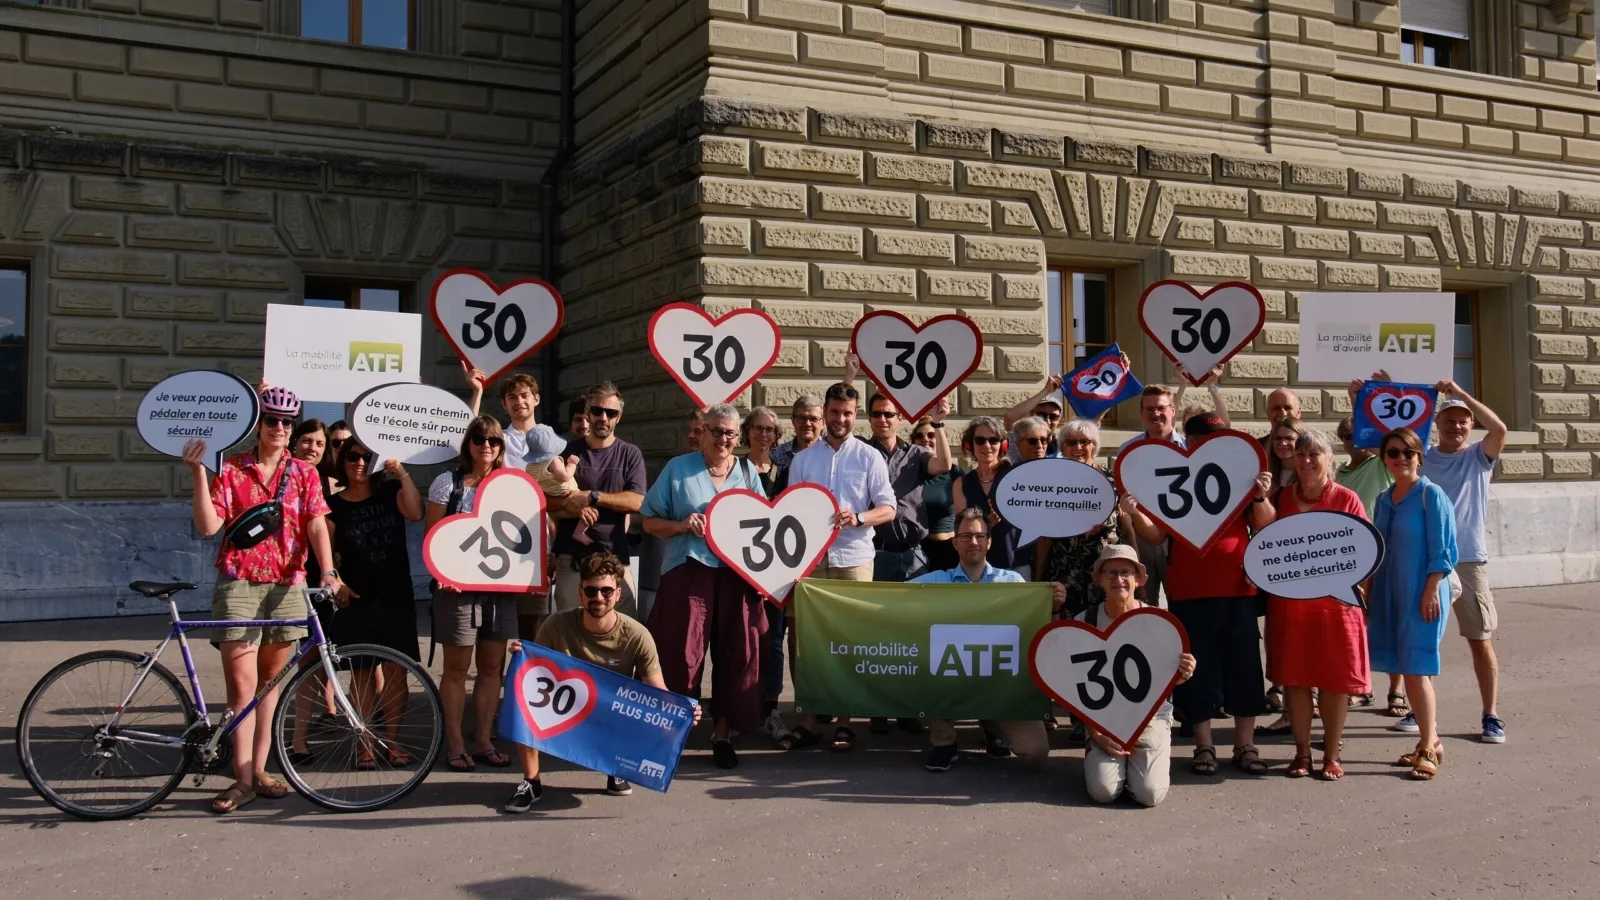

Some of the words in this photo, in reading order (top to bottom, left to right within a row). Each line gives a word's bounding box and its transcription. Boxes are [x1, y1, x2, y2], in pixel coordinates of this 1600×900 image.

[462, 299, 526, 353] 30
[1171, 307, 1231, 354] 30
[1318, 334, 1330, 342] La
[1332, 334, 1372, 342] mobilité
[1382, 334, 1432, 352] ATE
[286, 349, 298, 358] La
[301, 350, 342, 360] mobilité
[350, 352, 401, 372] ATE
[683, 334, 745, 383] 30
[885, 341, 947, 389] 30
[1085, 370, 1117, 392] 30
[156, 392, 169, 402] Je
[198, 394, 239, 404] pouvoir
[1378, 398, 1416, 420] 30
[150, 408, 191, 420] pédaler
[208, 411, 238, 420] toute
[366, 399, 380, 408] Je
[384, 402, 410, 412] veux
[414, 406, 427, 414] un
[430, 407, 470, 420] chemin
[168, 425, 214, 436] sécurité!
[365, 414, 380, 424] de
[422, 421, 438, 430] sûr
[440, 426, 467, 434] pour
[378, 432, 400, 442] mes
[404, 436, 450, 448] enfants!
[1012, 483, 1025, 492] Je
[1056, 486, 1098, 495] pouvoir
[1155, 462, 1231, 519] 30
[1007, 498, 1042, 507] dormir
[1045, 500, 1102, 510] tranquille!
[459, 510, 532, 579] 30
[740, 515, 806, 572] 30
[1258, 540, 1273, 550] Je
[1276, 536, 1305, 548] veux
[1308, 526, 1354, 544] pouvoir
[1263, 556, 1280, 566] me
[1284, 546, 1338, 563] déplacer
[1341, 545, 1356, 554] en
[1268, 569, 1300, 582] toute
[1304, 560, 1357, 576] sécurité!
[830, 641, 848, 654] La
[854, 643, 918, 656] mobilité
[936, 644, 1014, 676] ATE
[1070, 643, 1152, 710] 30
[528, 677, 576, 715] 30
[616, 686, 658, 708] MOINS
[662, 700, 688, 720] VITE,
[611, 701, 642, 720] PLUS
[645, 712, 673, 730] SÛR!
[641, 766, 662, 779] ATE
